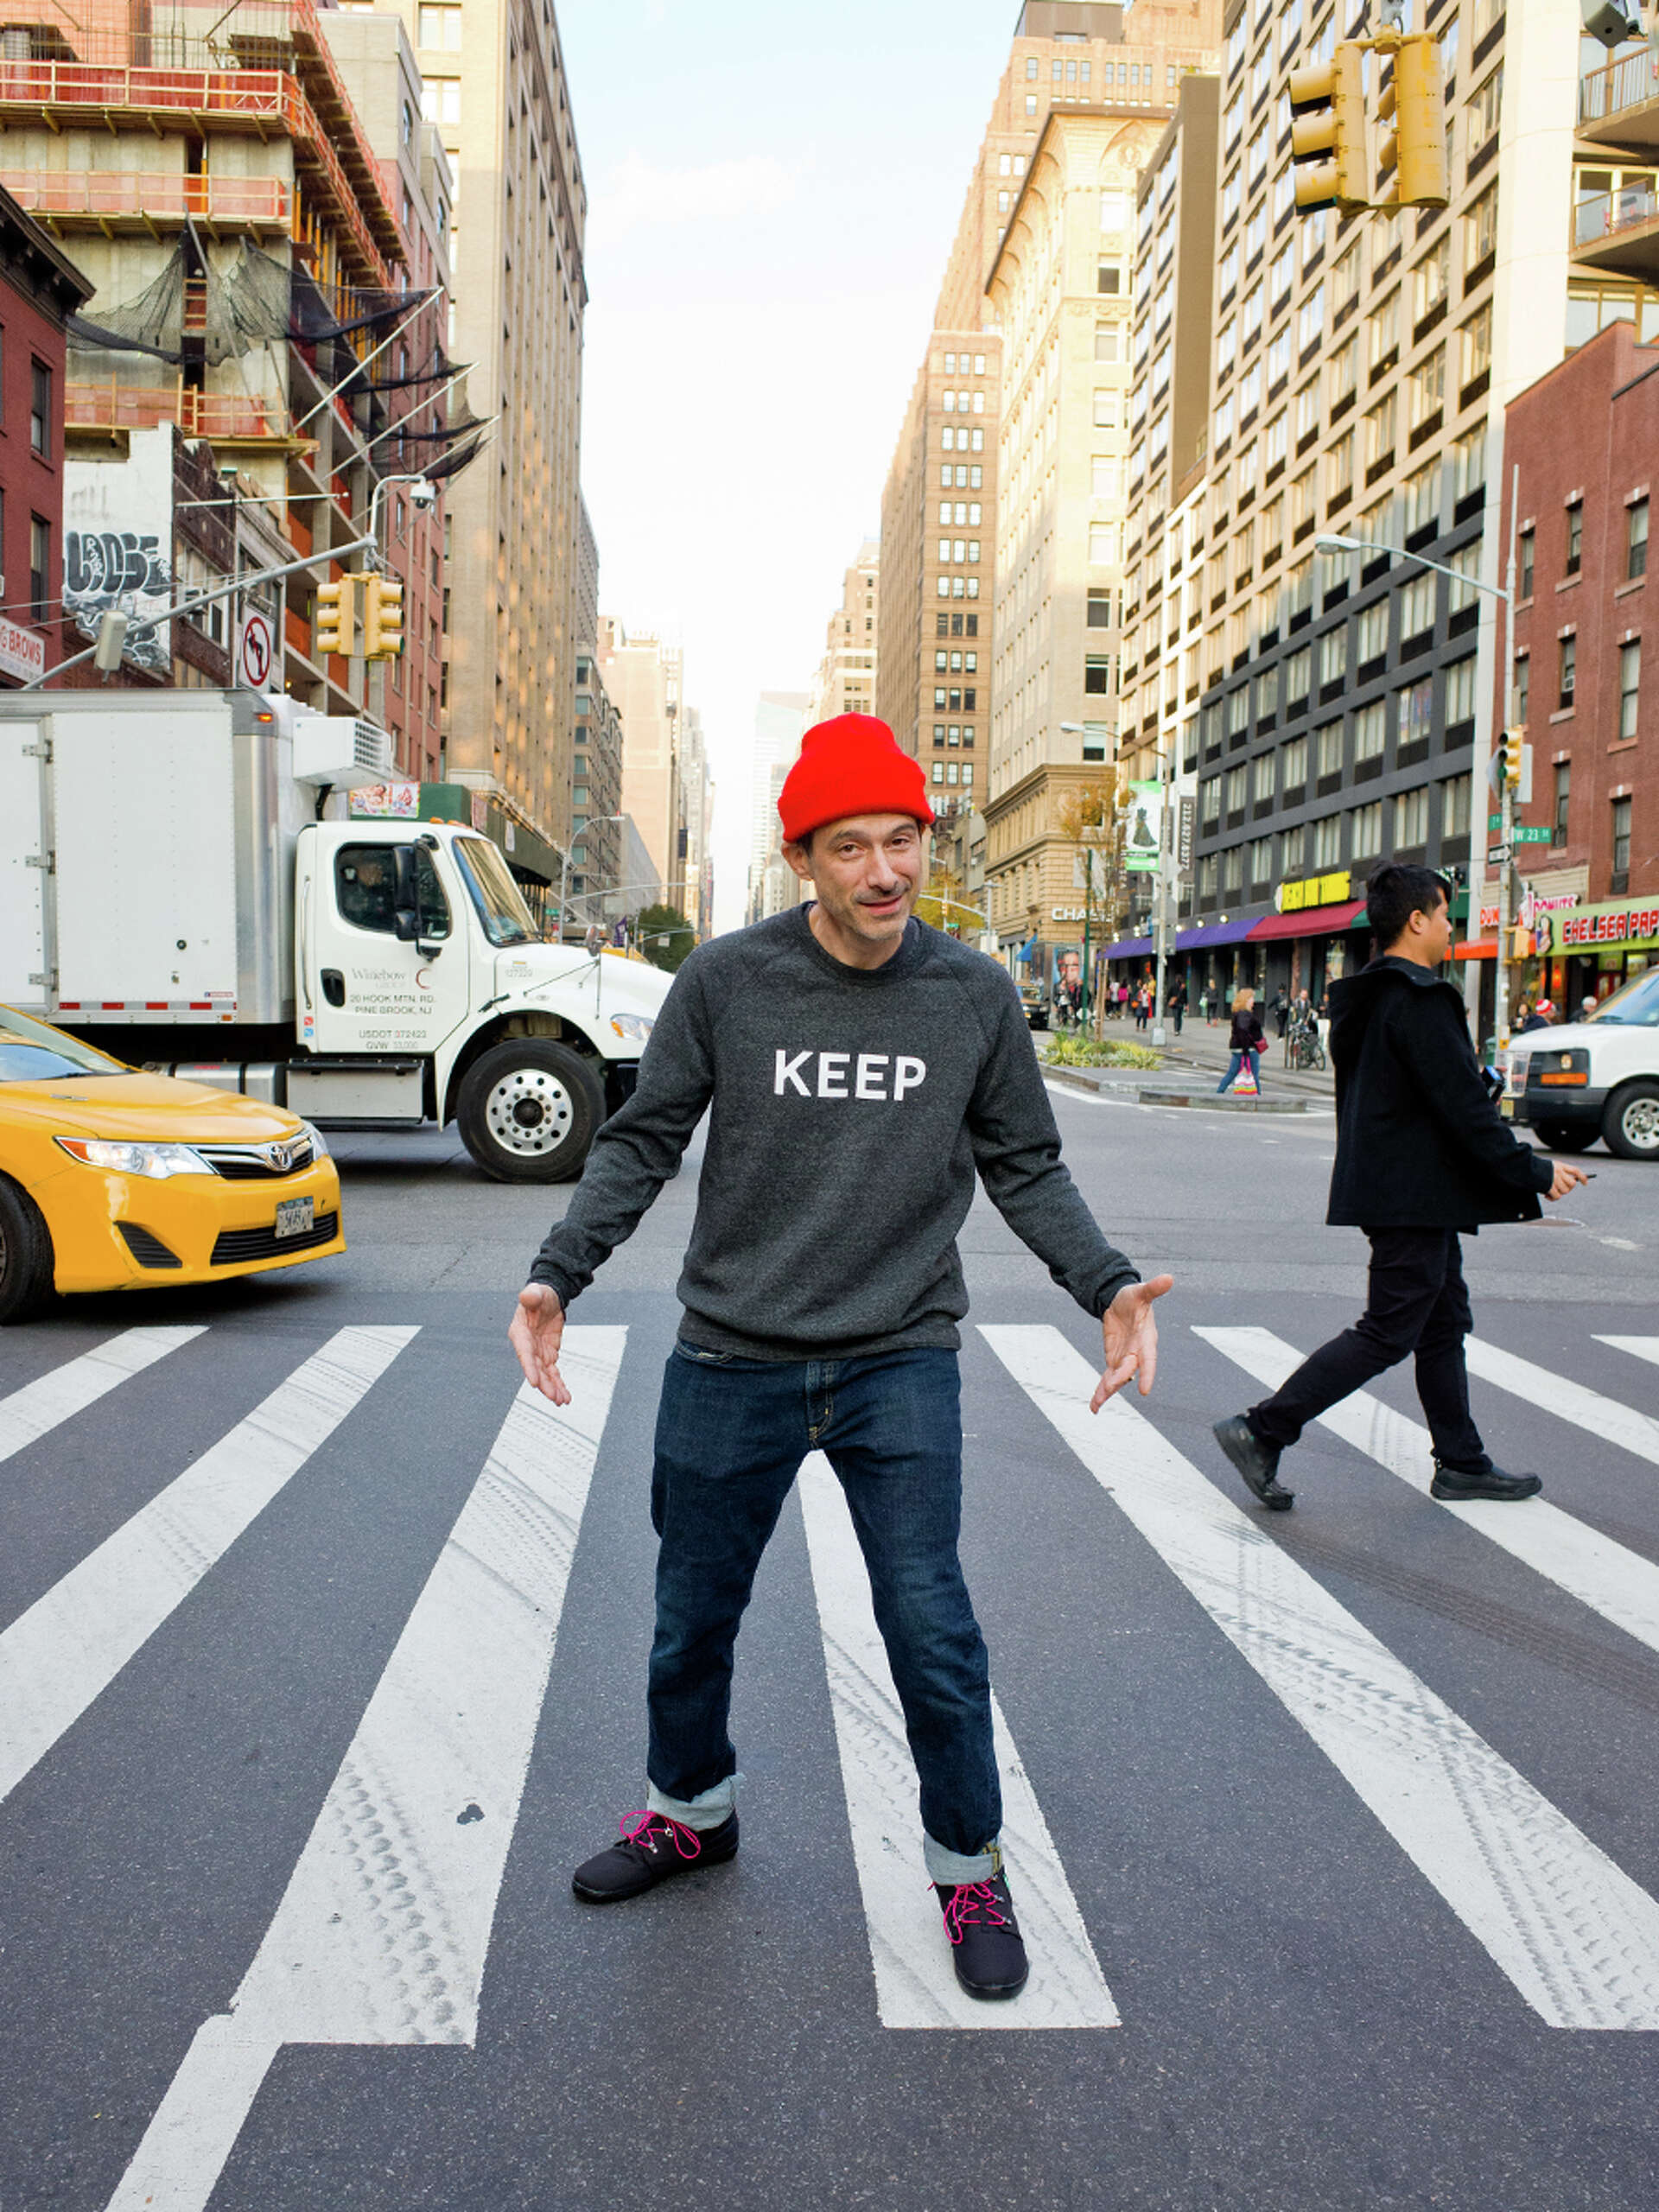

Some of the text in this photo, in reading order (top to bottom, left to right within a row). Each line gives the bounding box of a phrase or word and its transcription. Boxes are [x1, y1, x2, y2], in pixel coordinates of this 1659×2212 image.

[10, 630, 41, 665] BROWS
[1527, 829, 1538, 841] 23
[1479, 906, 1500, 927] DUN
[1562, 913, 1626, 944] CHELSEA
[363, 995, 391, 1003] HOOK
[420, 1006, 432, 1014] NJ
[774, 1049, 926, 1101] KEEP
